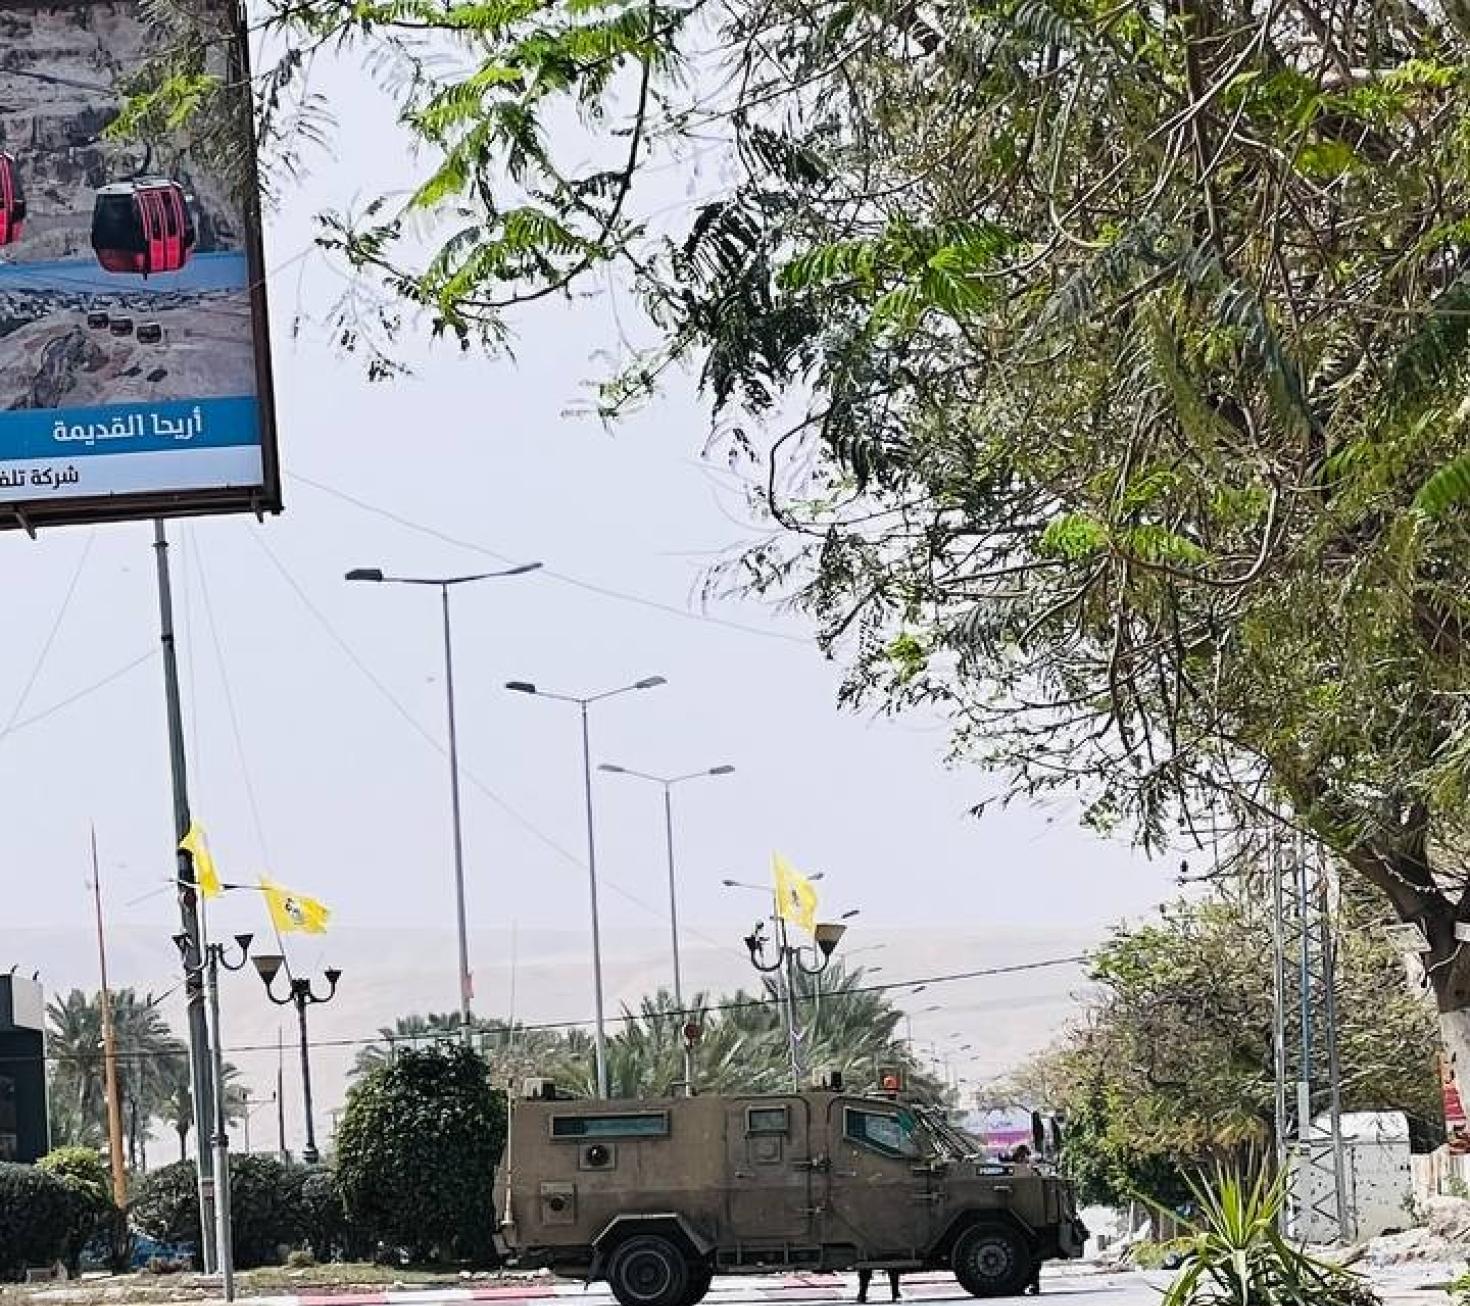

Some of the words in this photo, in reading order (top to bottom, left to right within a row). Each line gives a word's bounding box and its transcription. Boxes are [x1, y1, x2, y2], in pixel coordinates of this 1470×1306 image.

[53, 414, 143, 445] القديمة
[151, 405, 202, 439] أريحا
[31, 465, 78, 490] شركة
